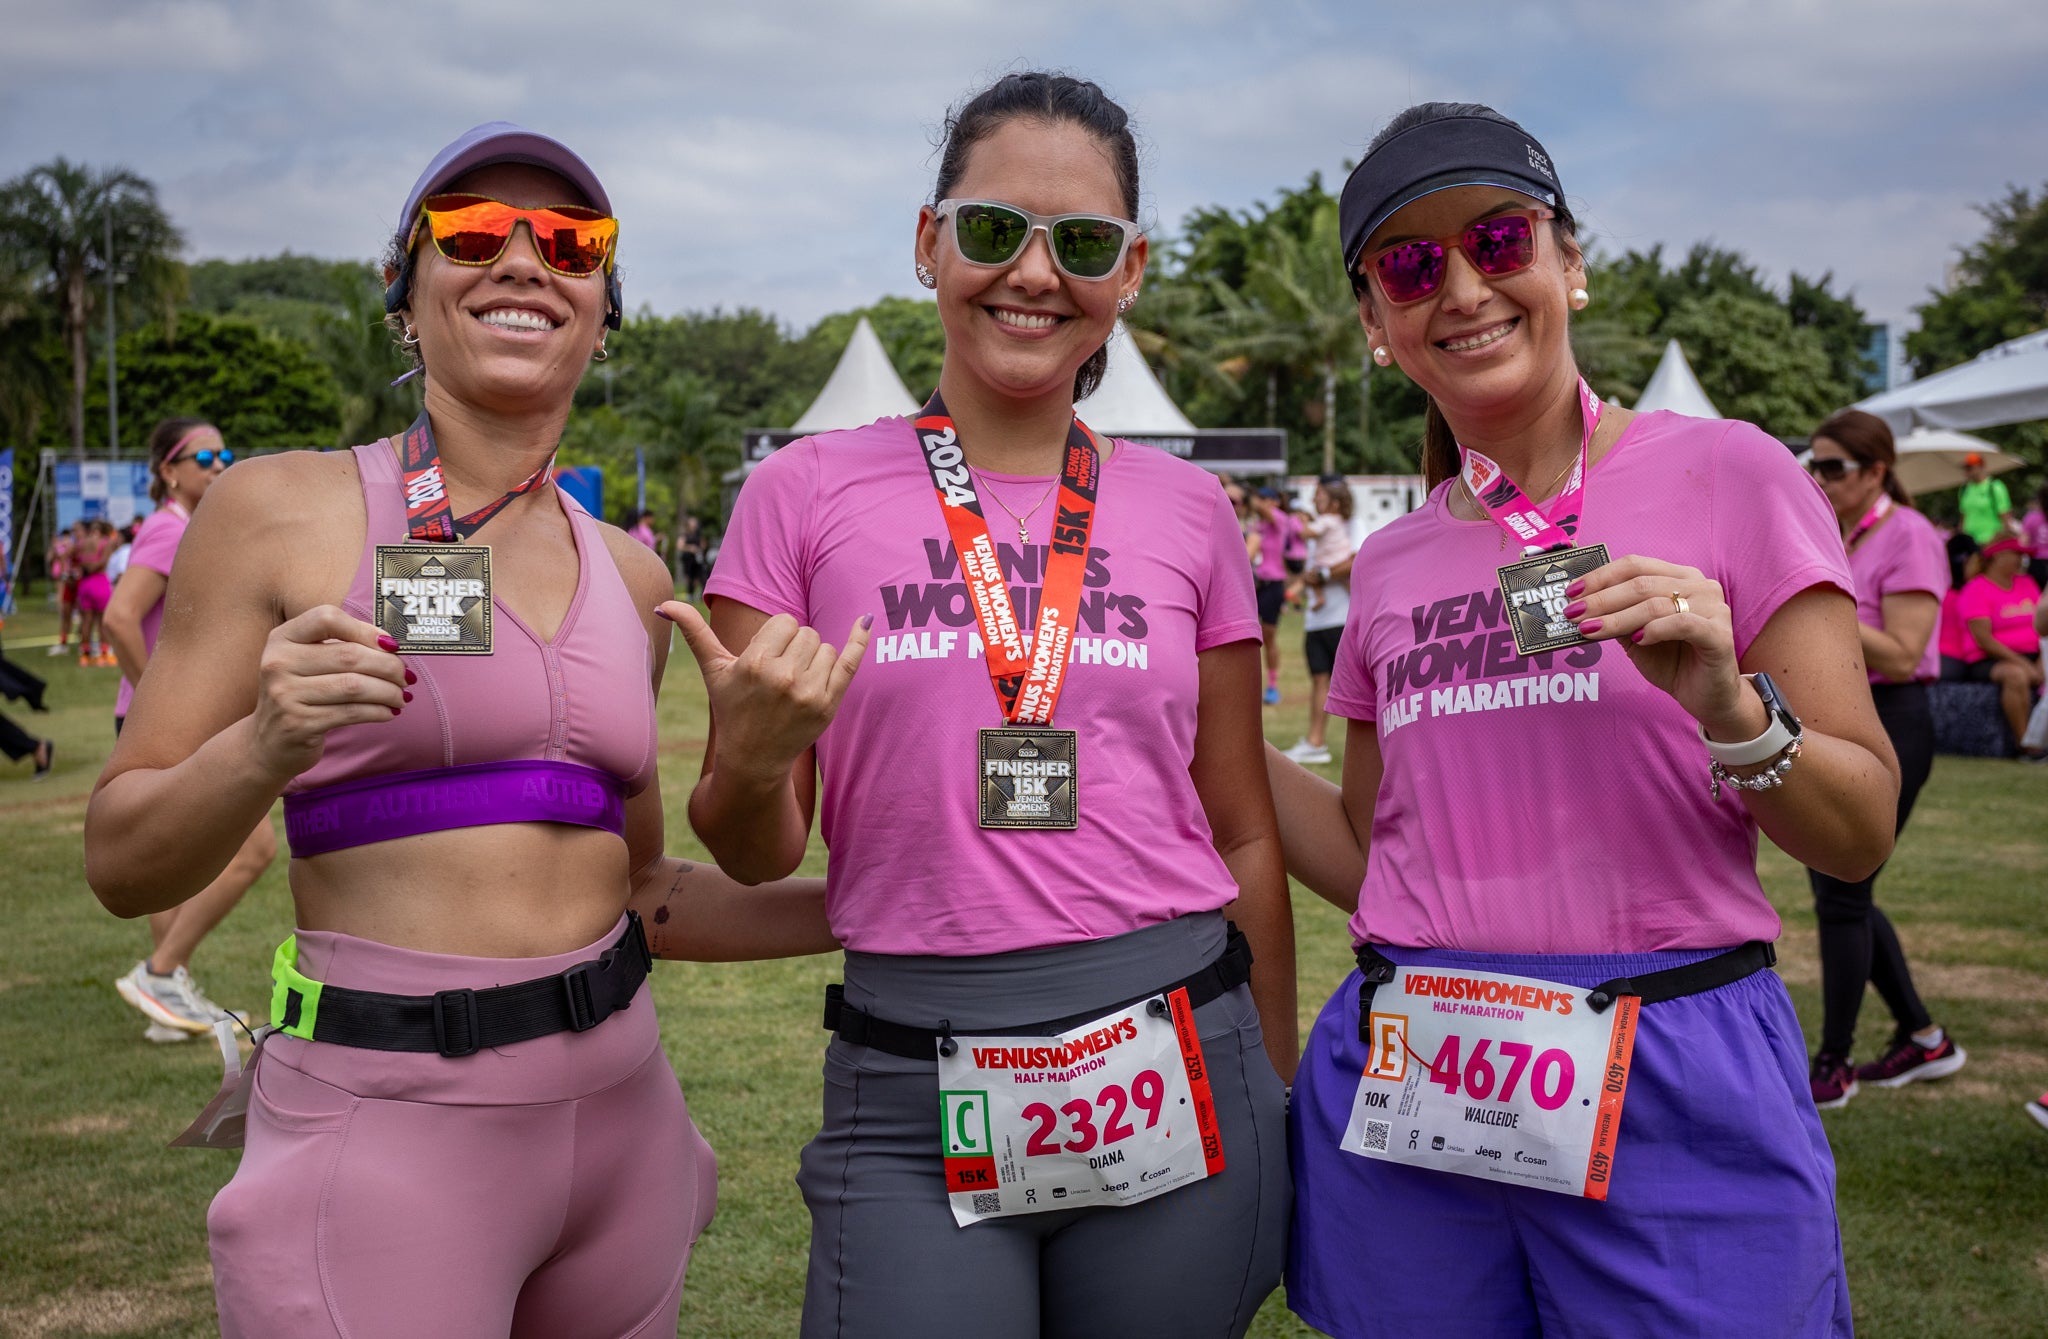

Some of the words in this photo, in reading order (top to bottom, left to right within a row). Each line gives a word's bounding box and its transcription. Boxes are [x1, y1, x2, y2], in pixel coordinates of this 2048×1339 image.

[1525, 144, 1548, 168] Track
[923, 426, 977, 508] 2024
[1066, 446, 1081, 478] VENUS
[1077, 446, 1093, 488] WOMEN'S
[1052, 504, 1091, 556] 15K
[923, 538, 1111, 588] VNS
[963, 550, 982, 578] HALF
[382, 579, 485, 597] FINISHER
[972, 533, 1001, 583] VENUS
[988, 582, 1023, 661] WOMEN'S
[1511, 580, 1570, 607] FINIS
[402, 595, 464, 616] 21.1K
[417, 616, 451, 625] VENUS
[972, 580, 1001, 646] MARATHON
[1412, 588, 1512, 646] VEN
[409, 625, 458, 635] WOMEN'S
[876, 632, 958, 664] HALF
[1016, 683, 1043, 724] ENUS
[1030, 606, 1059, 681] WOMEN'S
[1034, 695, 1053, 724] HALF
[1044, 626, 1069, 694] MARATHON
[1383, 692, 1423, 737] HALF
[1431, 671, 1599, 717] MARATHON
[986, 760, 1071, 776] FINISHER
[1014, 777, 1048, 795] 15K
[1015, 795, 1045, 803] VENUS
[362, 780, 489, 823] AUTHEN
[1008, 803, 1050, 811] WOMEN'S
[1404, 974, 1575, 1016] VENUSWOMEN'S
[1175, 998, 1194, 1052] GUARDA-VOLUME
[1433, 1001, 1459, 1014] HALF
[1460, 1005, 1524, 1021] MARATHON
[1615, 1002, 1631, 1061] GUARDA-VOLUME
[1381, 1023, 1398, 1072] E
[1014, 1073, 1045, 1084] HALF
[1186, 1054, 1203, 1081] 2329
[1430, 1034, 1575, 1111] 4670
[1606, 1062, 1626, 1093] 4670
[1021, 1069, 1165, 1157] 2329
[1364, 1091, 1391, 1109] 10K
[956, 1100, 977, 1149] C
[1200, 1101, 1210, 1131] MEDALHA
[1465, 1106, 1520, 1128] WALCLEIDE
[1599, 1113, 1612, 1147] MEDALHA
[1089, 1149, 1125, 1170] DIANA
[1203, 1133, 1220, 1159] 2329
[1475, 1145, 1502, 1161] Jeep
[1148, 1166, 1171, 1180] cosan
[1523, 1156, 1548, 1167] cosan
[1590, 1152, 1610, 1183] 4670
[1101, 1181, 1129, 1192] Jeep
